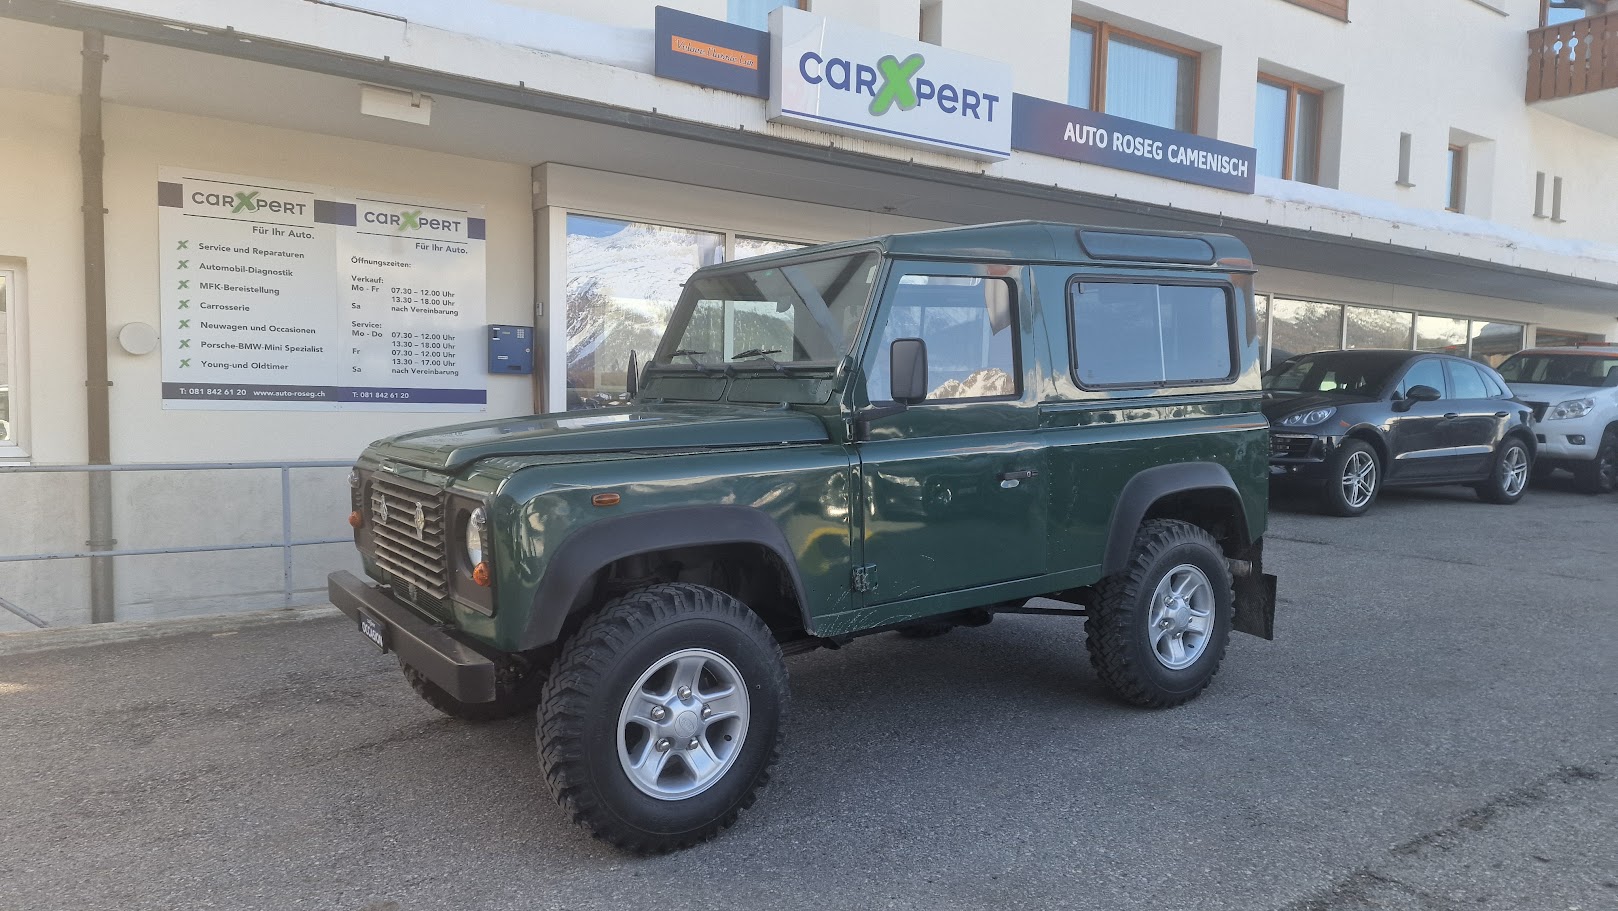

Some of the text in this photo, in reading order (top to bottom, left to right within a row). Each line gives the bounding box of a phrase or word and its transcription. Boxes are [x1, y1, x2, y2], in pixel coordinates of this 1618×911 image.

[1064, 122, 1248, 178] AUTO ROSEG CAMENISCH
[252, 226, 315, 239] Für Ihr Auto.
[199, 243, 230, 253] Service
[252, 248, 305, 259] Reparaturen
[415, 242, 468, 254] Für Ihr Auto.
[351, 256, 412, 268] Öffnungszeiten:
[199, 263, 293, 277] Automobil-Diagnostik
[351, 275, 384, 284] Verkauf:
[199, 282, 280, 296] MFK-Bereistellung
[351, 284, 364, 292] Mo
[371, 285, 379, 293] Fr
[391, 287, 412, 295] 07.30
[421, 289, 440, 297] 12.00
[442, 290, 455, 298] Uhr
[200, 302, 250, 312] Carrosserie
[392, 296, 412, 304] 13.30
[421, 298, 440, 306] 18.00
[442, 299, 455, 307] Uhr
[351, 302, 361, 310] Sa
[411, 306, 459, 316] Vereinbarung
[200, 322, 248, 332] Neuwagen
[269, 326, 316, 334] Occasionen
[351, 321, 382, 329] Service:
[372, 330, 382, 338] Do
[201, 341, 324, 353] Porsche-BMW-Mini Spezialist
[392, 340, 412, 348] 13.30
[391, 349, 412, 357] 07.30
[201, 360, 289, 370] Young-und Oldtimer
[392, 358, 412, 366] 13.30
[411, 368, 459, 376] Vereinbarung
[253, 390, 326, 398] www.auto-roseg.ch
